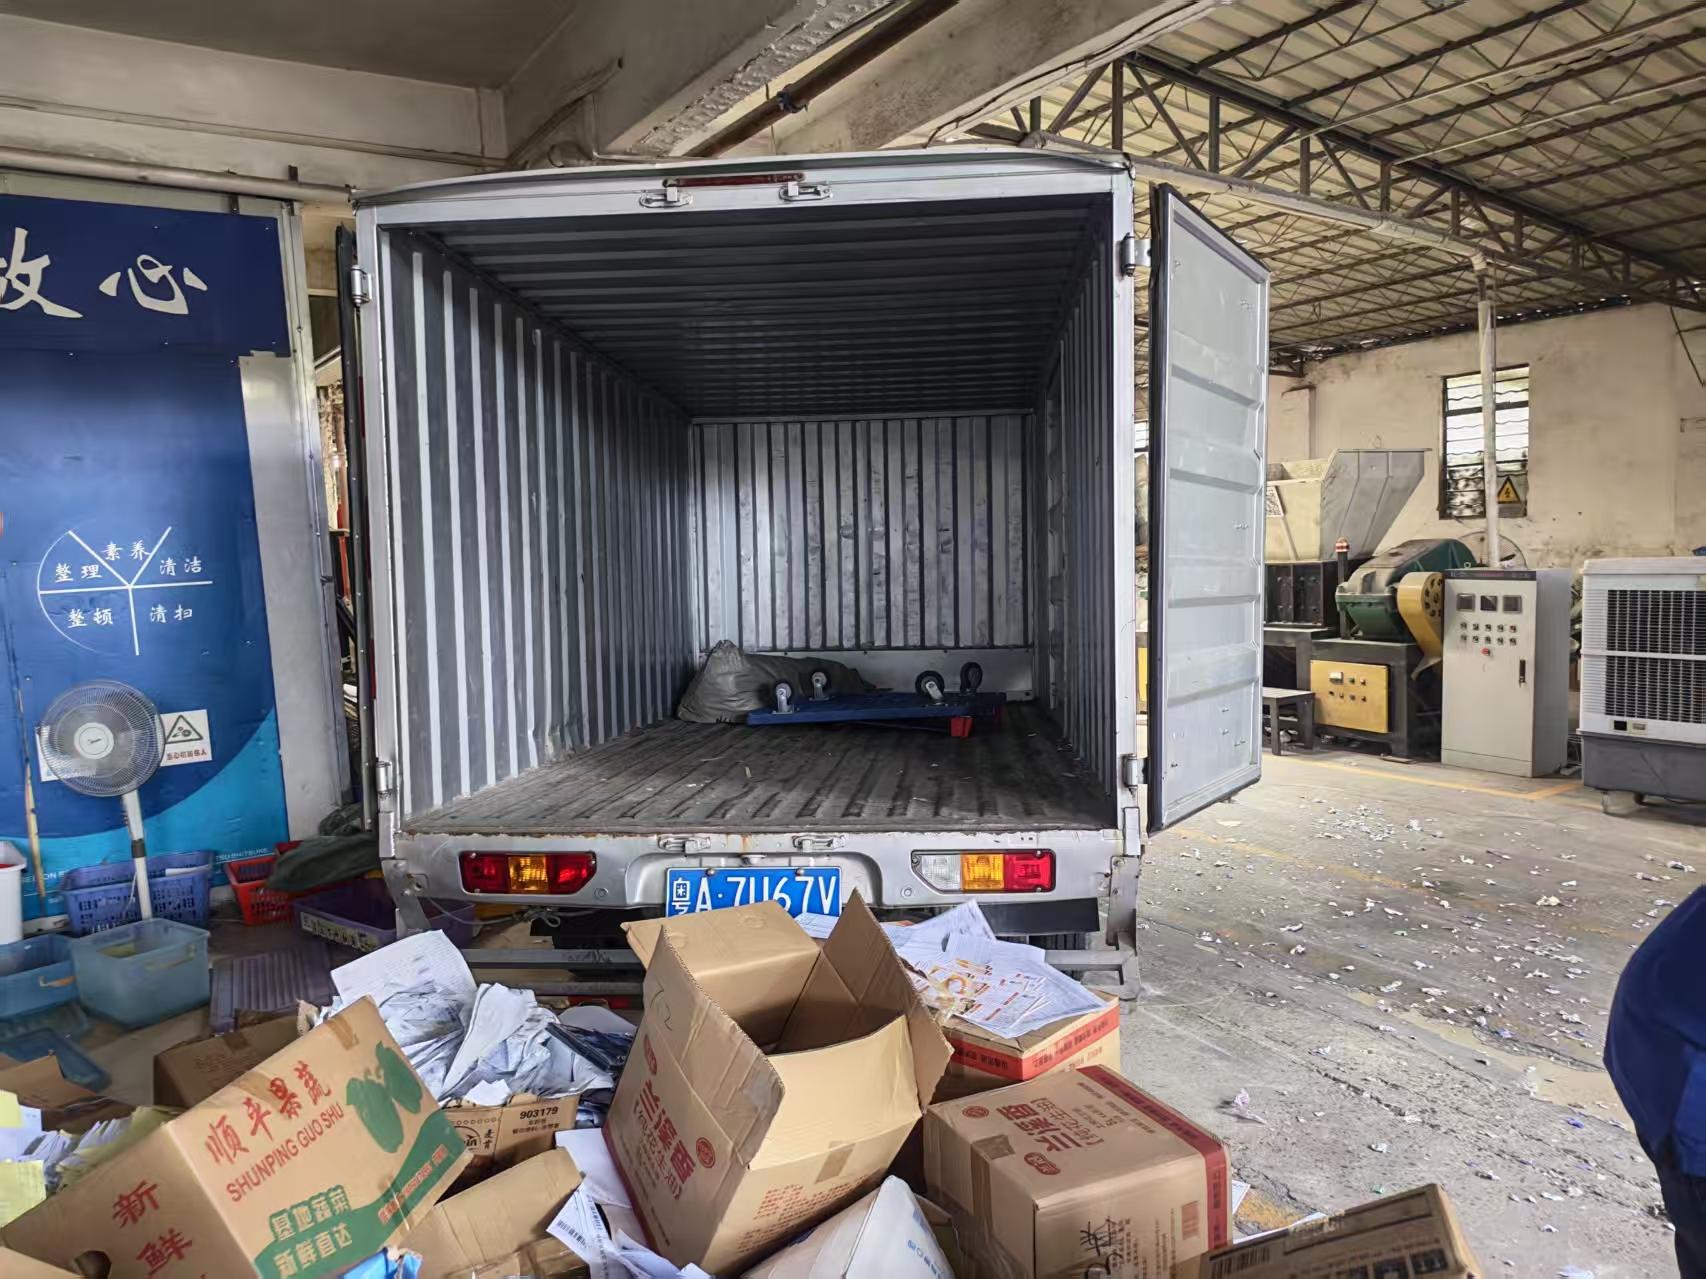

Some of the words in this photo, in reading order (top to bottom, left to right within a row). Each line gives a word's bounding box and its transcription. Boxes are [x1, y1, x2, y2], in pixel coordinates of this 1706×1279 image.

[101, 539, 151, 561] 素养
[159, 556, 203, 576] 清洁
[55, 563, 103, 583] 整理
[67, 608, 114, 629] 整顿
[150, 604, 193, 624] 清扫
[204, 1060, 332, 1165] 顺平果蔬
[520, 1106, 559, 1120] 903179
[996, 1103, 1083, 1152] 兰溪香
[226, 1138, 299, 1202] SHUNPING
[296, 1119, 324, 1148] GUO
[320, 1101, 345, 1129] SHU
[112, 1179, 193, 1279] 新鲜
[272, 1187, 350, 1242] 基地蔬菜
[273, 1221, 353, 1279] 新鲜直达
